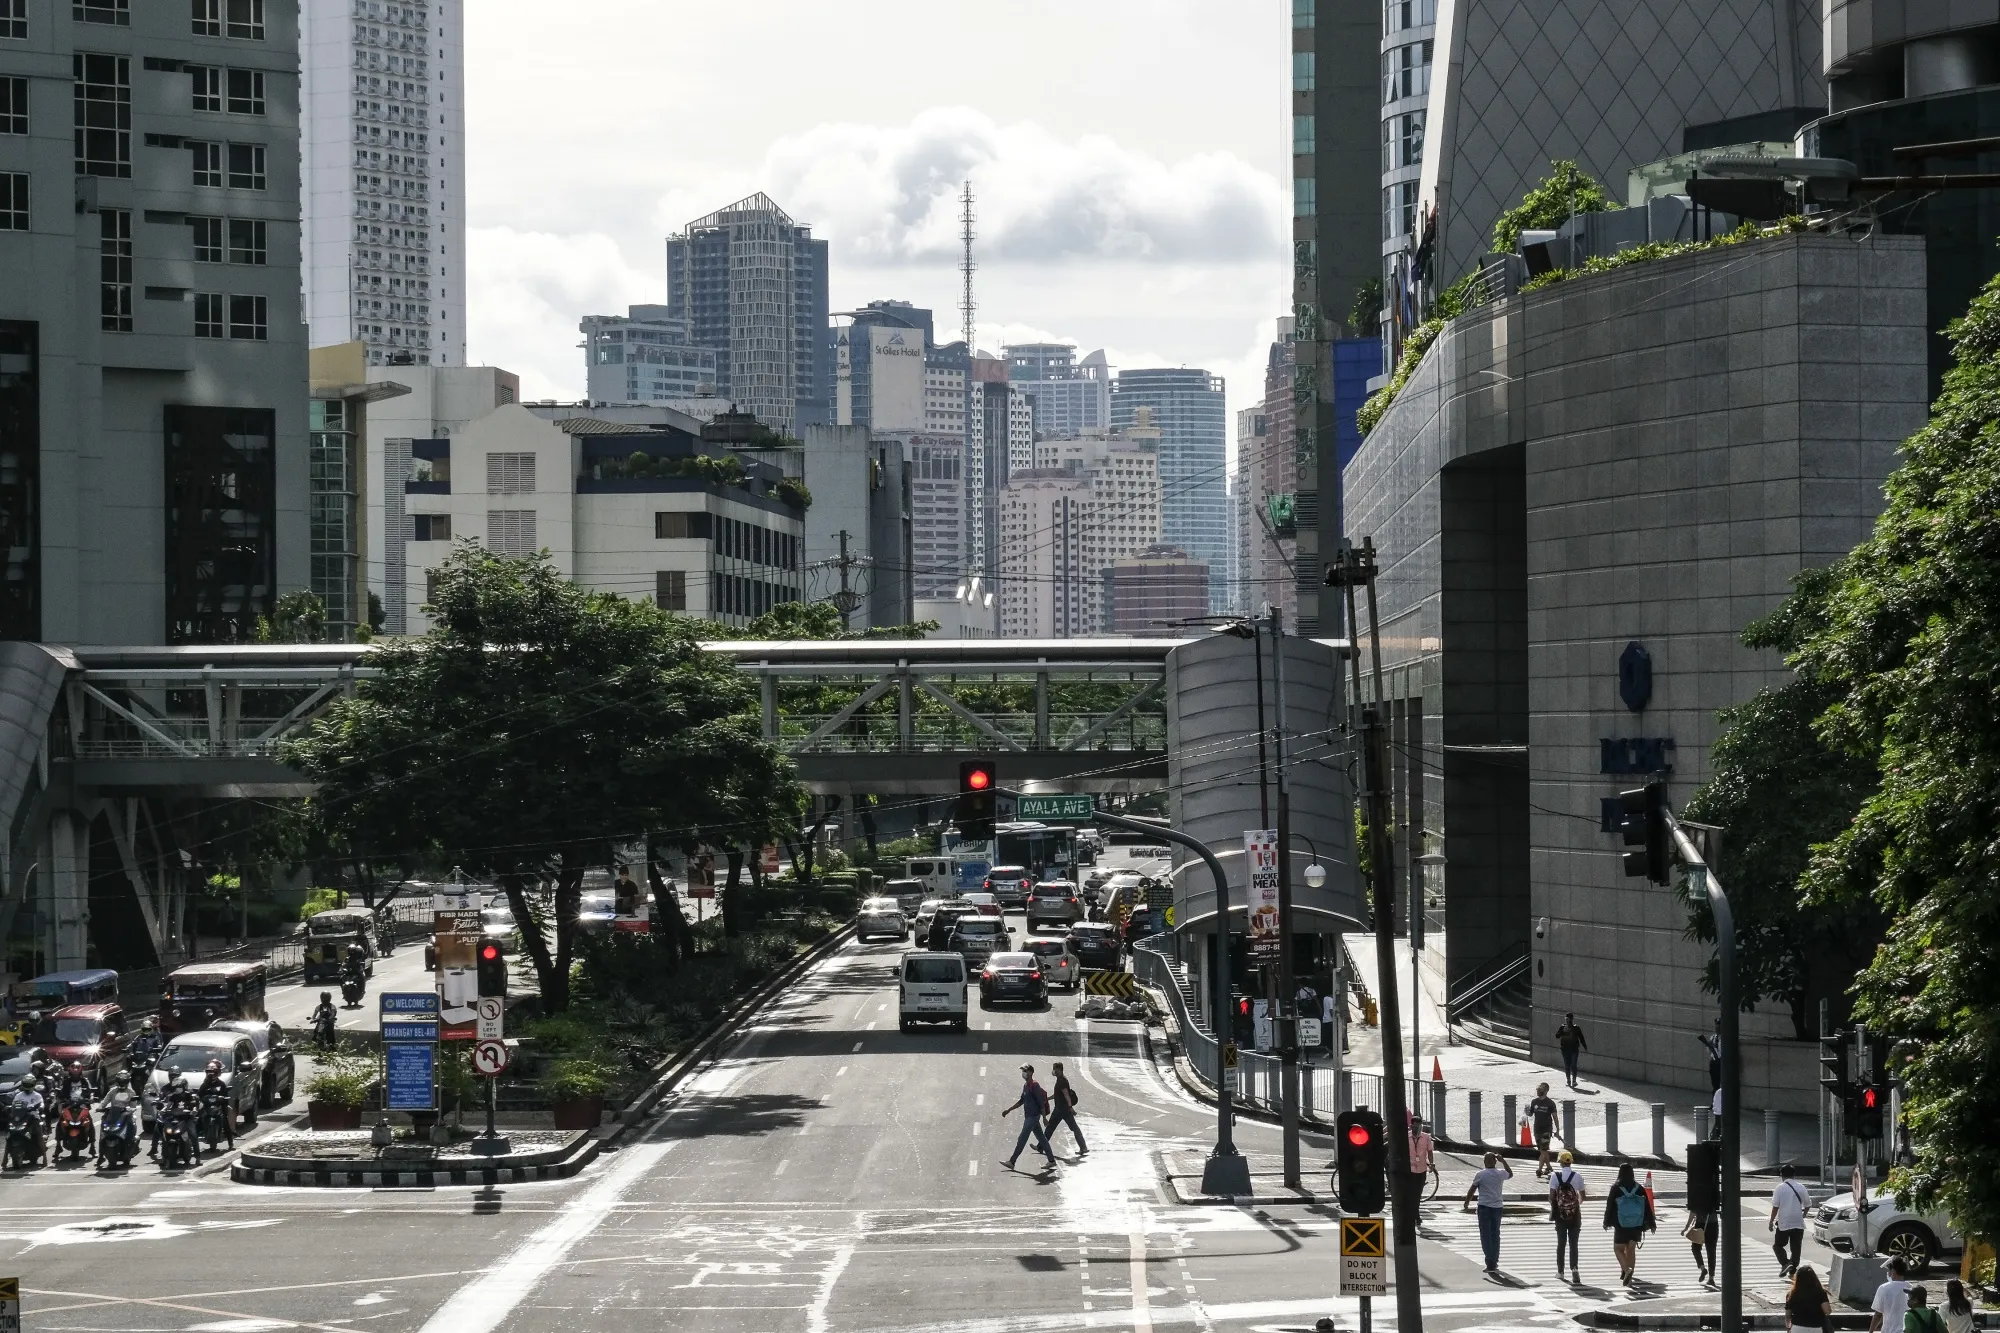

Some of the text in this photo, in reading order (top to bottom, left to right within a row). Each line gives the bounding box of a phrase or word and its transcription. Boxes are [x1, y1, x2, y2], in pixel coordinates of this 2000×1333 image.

[875, 345, 920, 357] St Giles Hotel
[923, 438, 964, 446] City Garden
[1023, 801, 1059, 815] AYALA
[1063, 800, 1088, 814] AVE.
[1252, 872, 1279, 880] BUCKE
[1253, 879, 1279, 889] MEA
[395, 998, 426, 1009] WELCOME
[384, 1027, 413, 1038] BARANGAY
[414, 1027, 436, 1037] BEL-AIR
[1347, 1260, 1378, 1269] DO NOT
[1349, 1272, 1378, 1280] BLOCK
[1340, 1283, 1386, 1292] INTERSECTION
